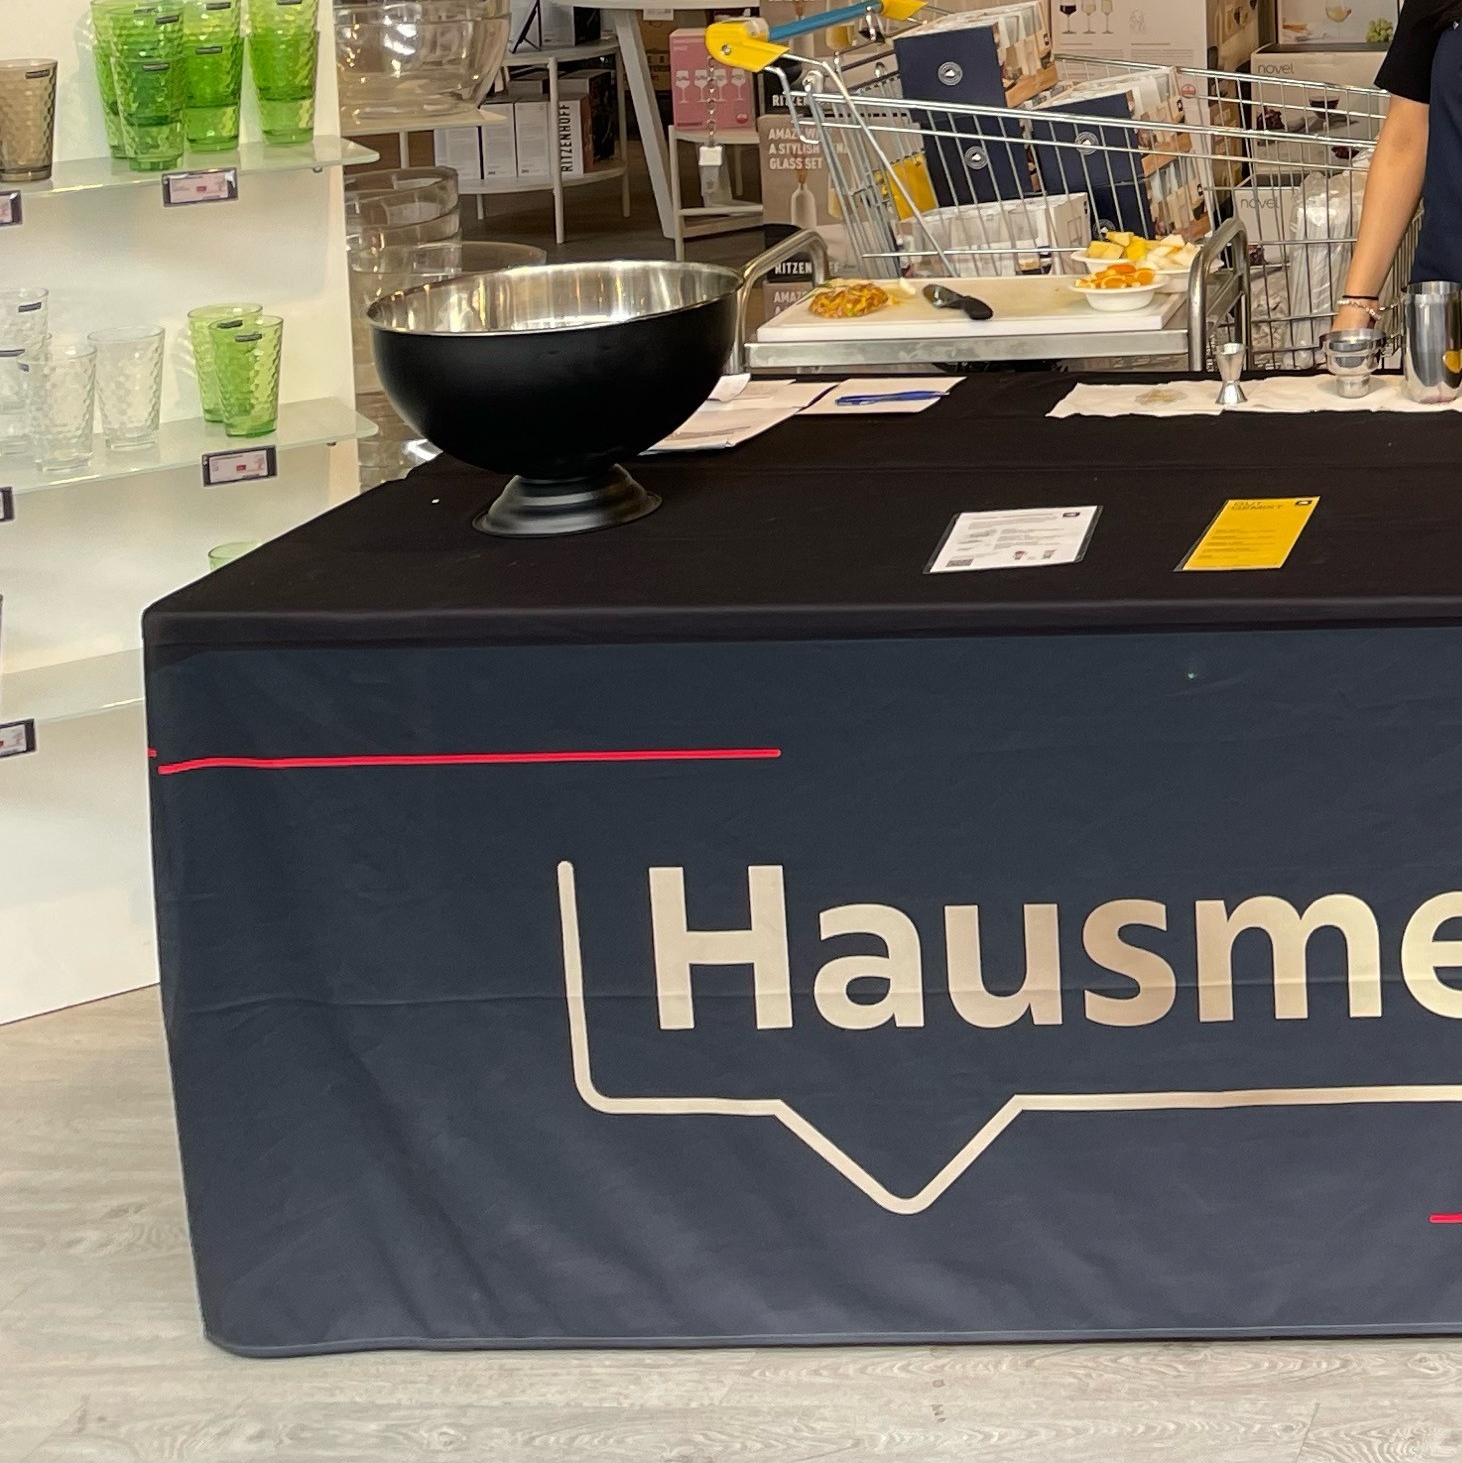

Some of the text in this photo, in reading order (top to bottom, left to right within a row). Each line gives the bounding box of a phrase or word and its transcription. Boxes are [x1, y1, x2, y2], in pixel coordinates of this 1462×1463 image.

[1257, 62, 1294, 75] novel
[778, 144, 821, 155] STYLISH
[769, 158, 823, 170] GLASS SET
[1240, 196, 1280, 210] novel
[774, 261, 839, 274] RITZENFF
